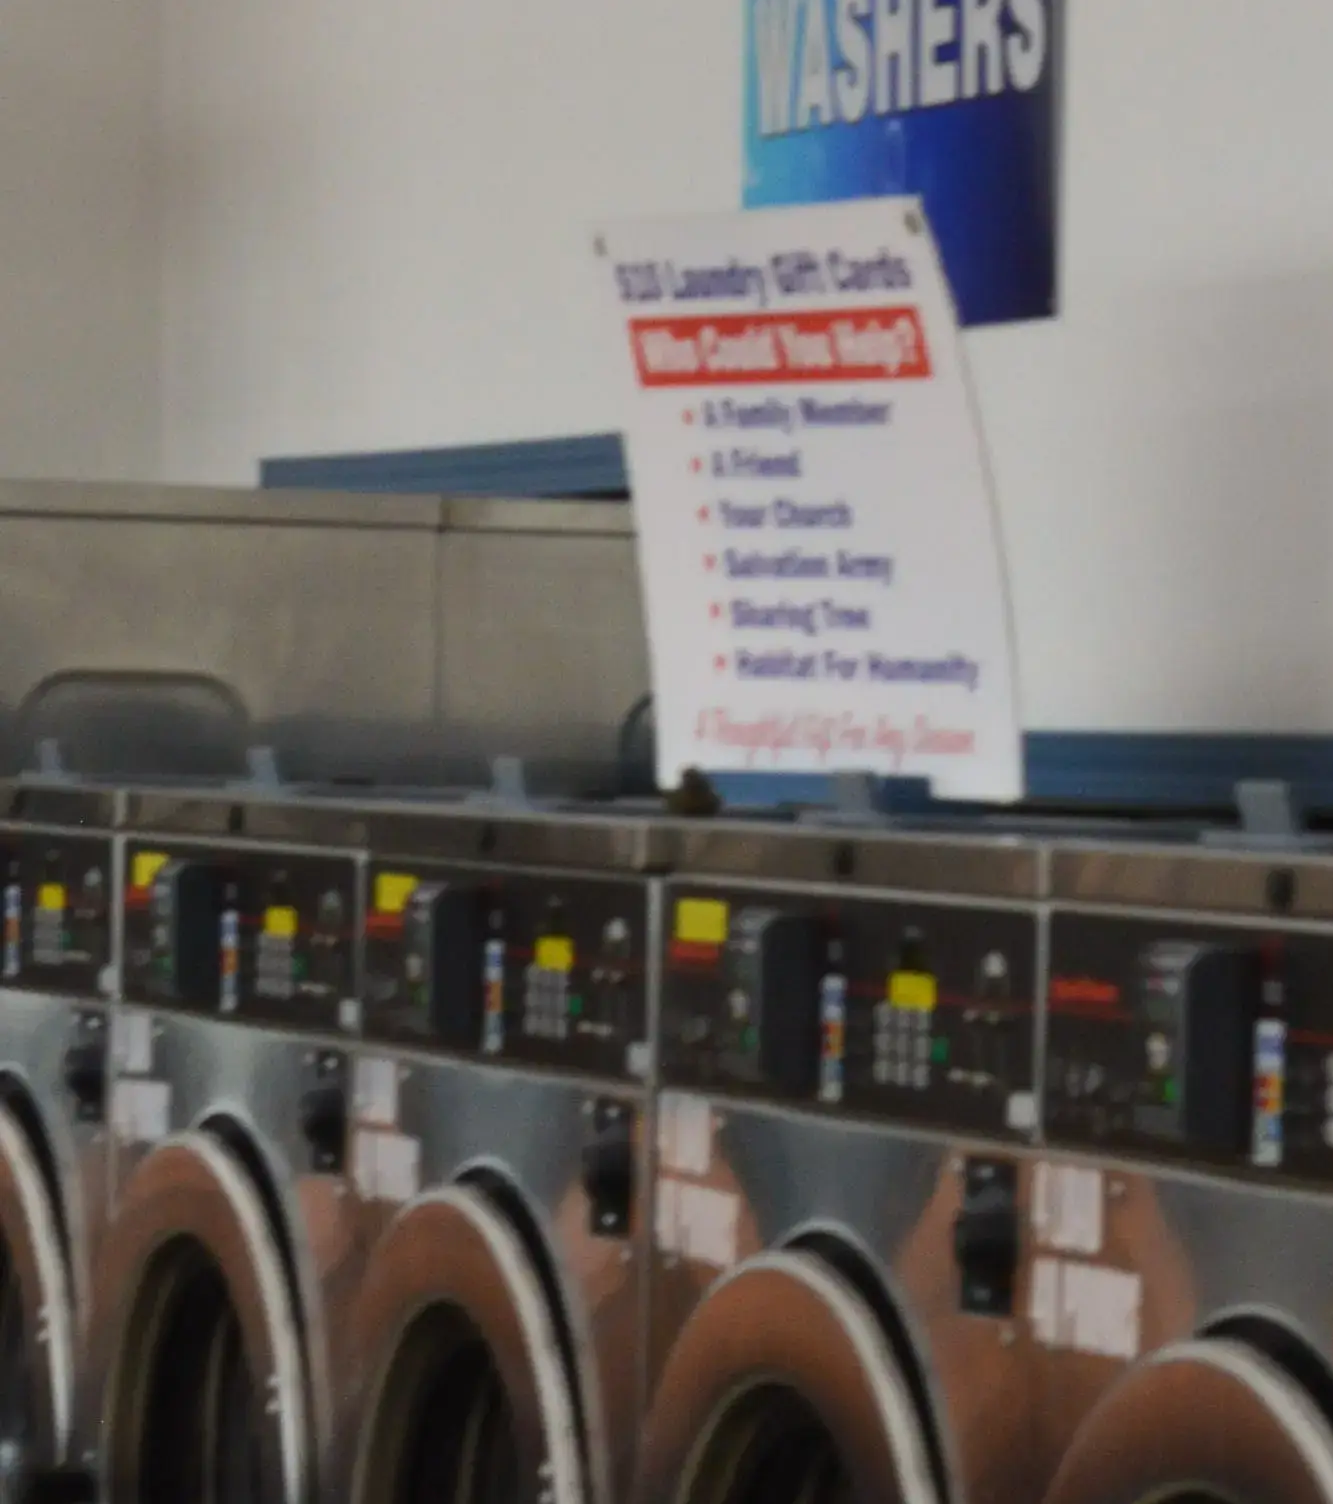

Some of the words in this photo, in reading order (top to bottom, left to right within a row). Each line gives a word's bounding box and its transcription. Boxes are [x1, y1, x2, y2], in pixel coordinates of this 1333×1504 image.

[664, 257, 768, 308] Laundry
[770, 249, 826, 295] Gift
[827, 246, 913, 292] Cards
[638, 327, 697, 372] Who
[777, 322, 834, 370] You
[719, 396, 795, 434] Family
[797, 396, 892, 426] Member
[730, 447, 801, 478] Friend
[718, 498, 766, 529] Your
[773, 498, 853, 529] Church
[724, 547, 828, 580] Salvation
[836, 547, 895, 587] Army
[730, 598, 818, 637] Sharing
[819, 597, 870, 630] Tree
[735, 647, 817, 681] Habitat
[822, 648, 859, 681] For
[866, 650, 980, 693] Humanity
